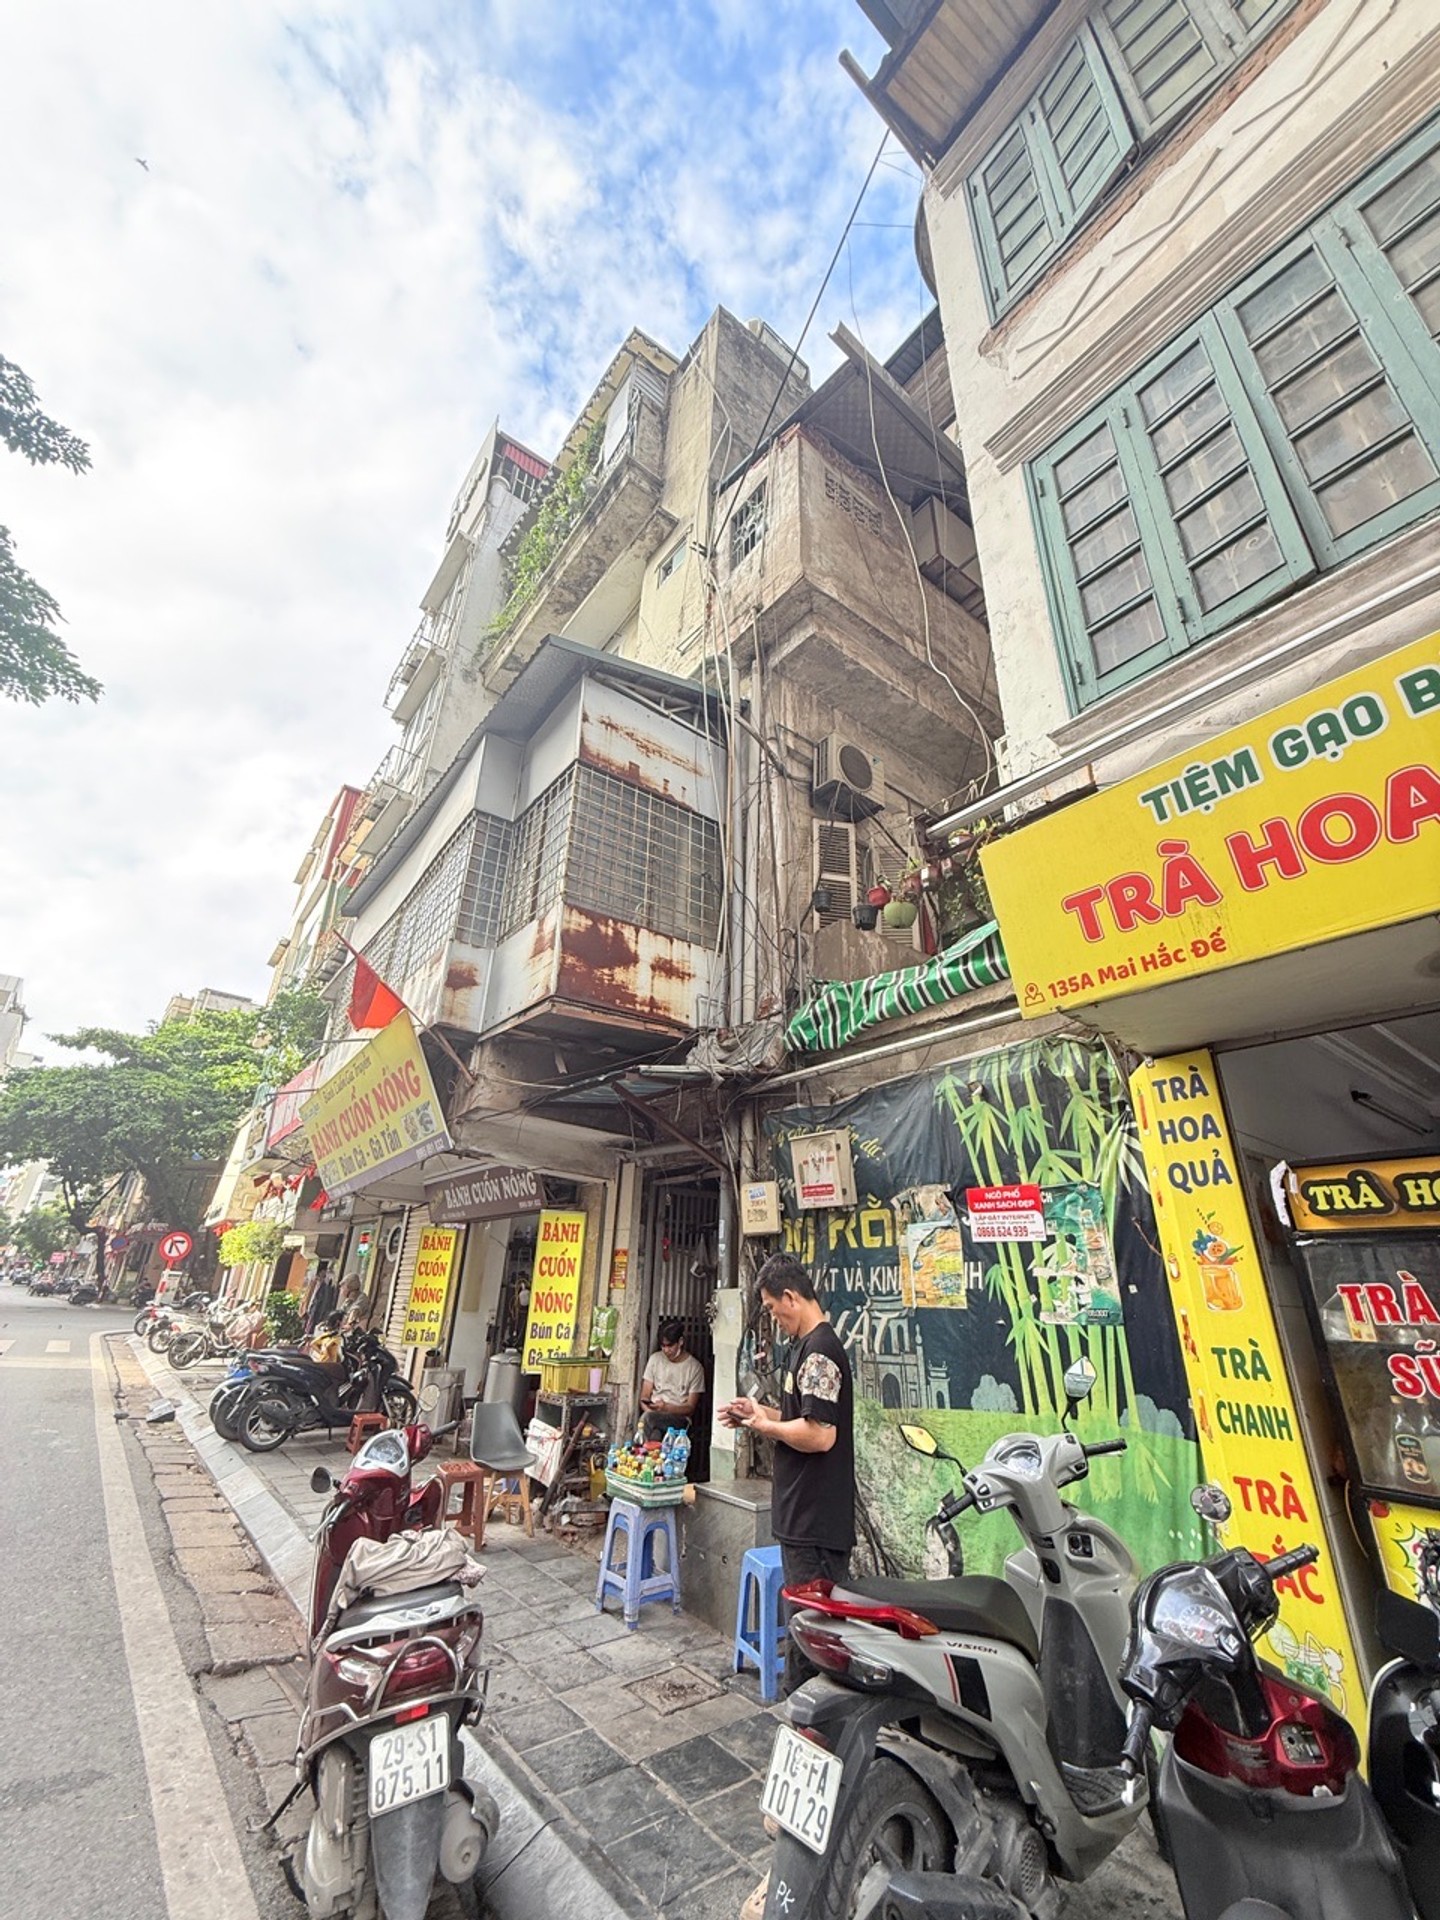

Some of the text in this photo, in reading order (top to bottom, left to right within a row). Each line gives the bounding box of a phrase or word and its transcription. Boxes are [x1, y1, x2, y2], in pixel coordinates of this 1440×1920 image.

[1141, 749, 1261, 823] TIỆM
[1271, 695, 1385, 768] GẠO
[1062, 765, 1440, 943] TRÀ HOA
[1048, 926, 1227, 999] 135A Mai Hắc Đế
[1152, 1066, 1209, 1103] TRÀ
[311, 1058, 421, 1161] BÁNH CUỐN NÓNG
[1157, 1113, 1221, 1144] HOA
[444, 1169, 537, 1209] BÁNH CUỐN NÓNG
[1167, 1149, 1232, 1194] QUẢ
[974, 1199, 1035, 1211] XANH SẠCH ĐẸP
[1003, 1187, 1021, 1199] PHỐ
[1308, 1176, 1384, 1210] TRÀ
[422, 1232, 452, 1251] BÁNH
[542, 1216, 581, 1243] BÁNH
[417, 1254, 448, 1277] CUỐN
[538, 1248, 577, 1278] CUỐN
[843, 1260, 865, 1292] VÀ
[869, 1265, 902, 1294] KIN
[412, 1283, 444, 1303] NÓNG
[533, 1286, 573, 1314] NÓNG
[1337, 1271, 1440, 1325] TRÀ
[408, 1309, 440, 1323] Bún Cá
[530, 1321, 571, 1340] Bún Cá
[405, 1328, 417, 1342] Gà
[1211, 1338, 1272, 1382] TRÀ
[1215, 1400, 1293, 1441] CHANH
[1233, 1471, 1308, 1523] TRÀ
[1250, 1534, 1324, 1604] ẮC
[946, 1641, 998, 1654] VISION
[382, 1722, 437, 1770] 29-S1
[375, 1754, 443, 1809] 875.11
[768, 1773, 829, 1844] 101.29
